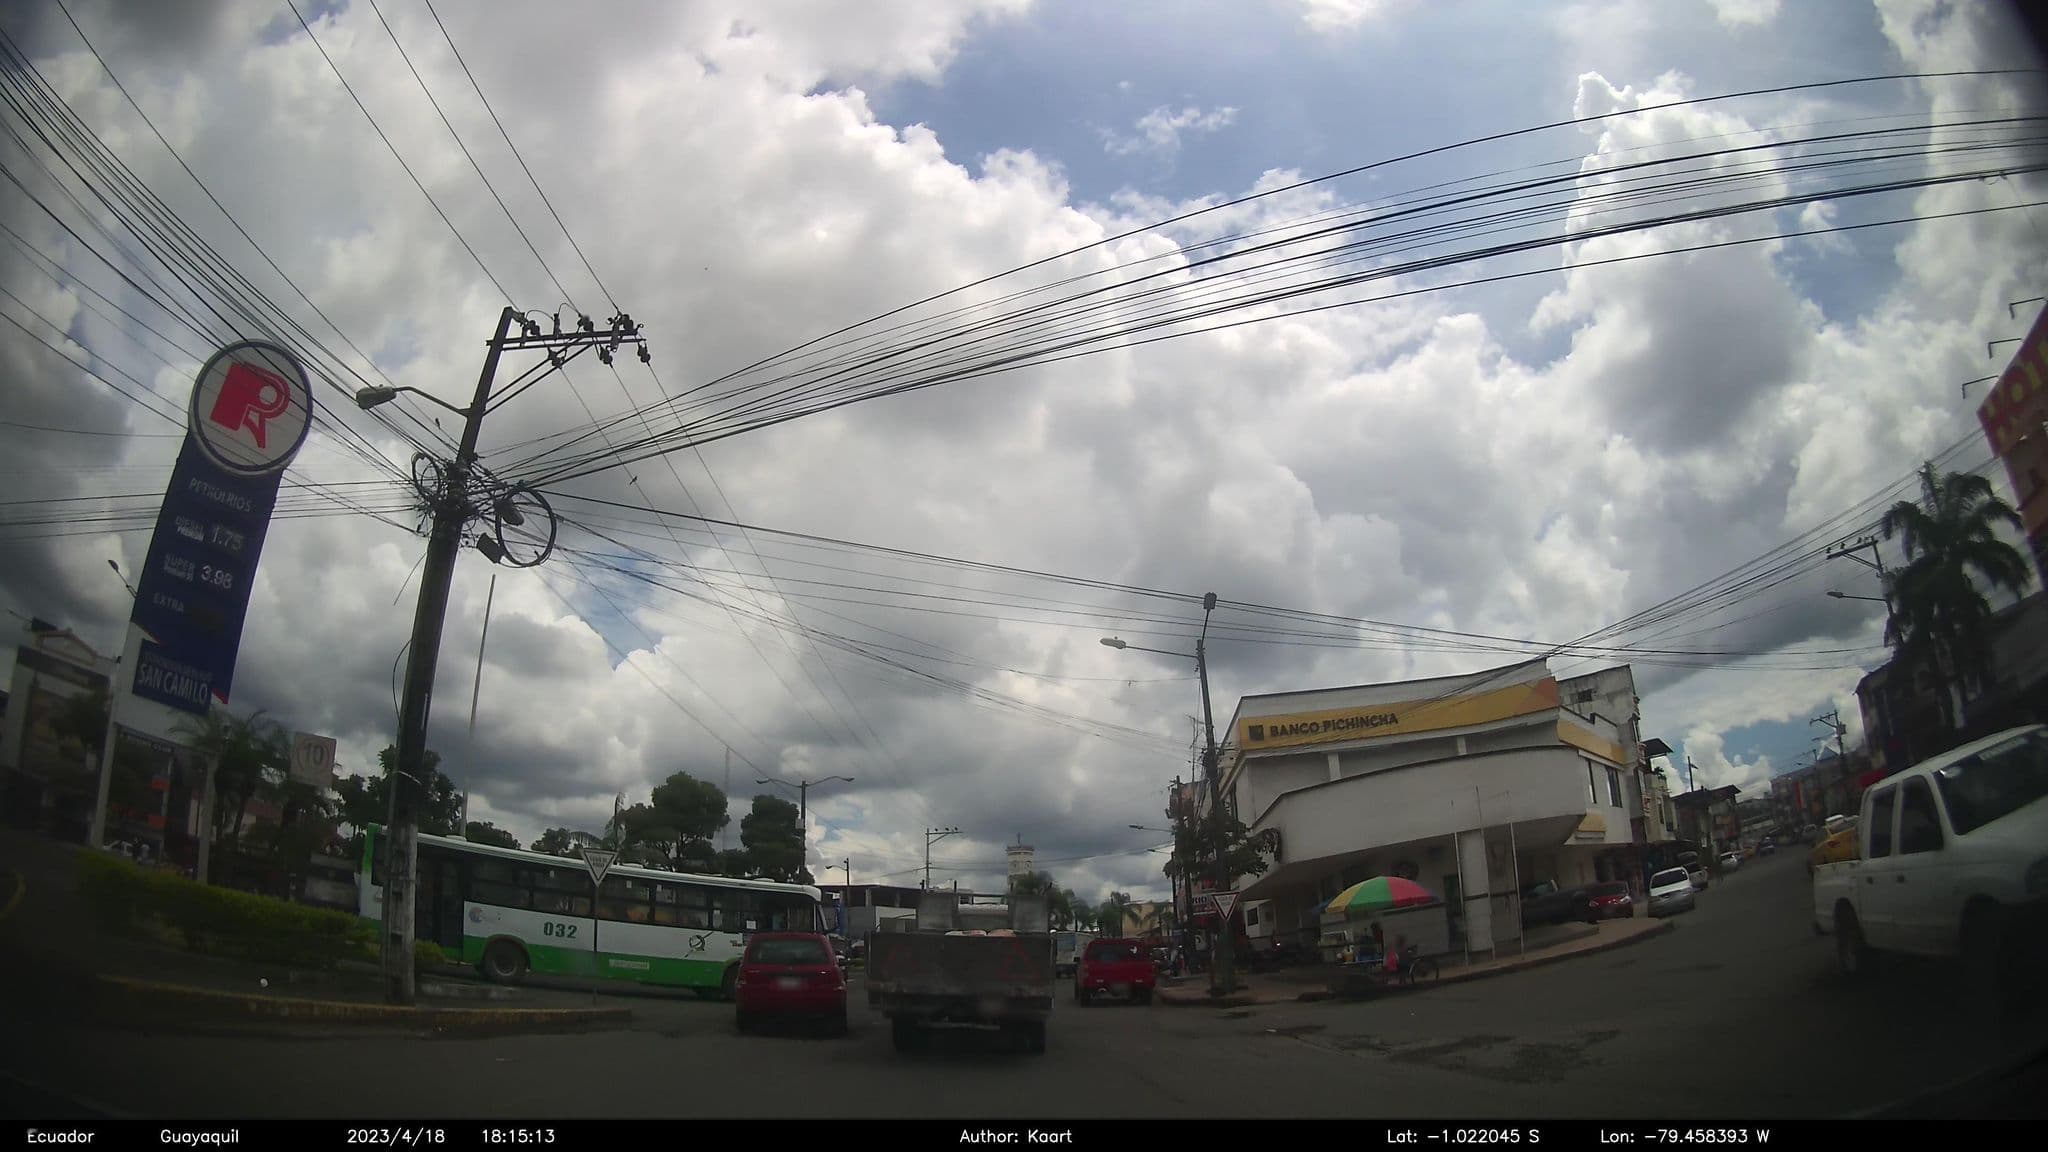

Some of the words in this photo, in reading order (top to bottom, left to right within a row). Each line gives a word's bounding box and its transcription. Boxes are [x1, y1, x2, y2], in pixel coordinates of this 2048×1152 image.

[200, 564, 233, 589] 3.98
[153, 592, 184, 613] EXTRA
[139, 663, 162, 689] SAN
[163, 671, 209, 705] CAMILO
[1269, 721, 1321, 738] BANCO
[1322, 712, 1399, 733] PICHINCHA
[304, 742, 324, 767] 10
[543, 921, 578, 939] 032
